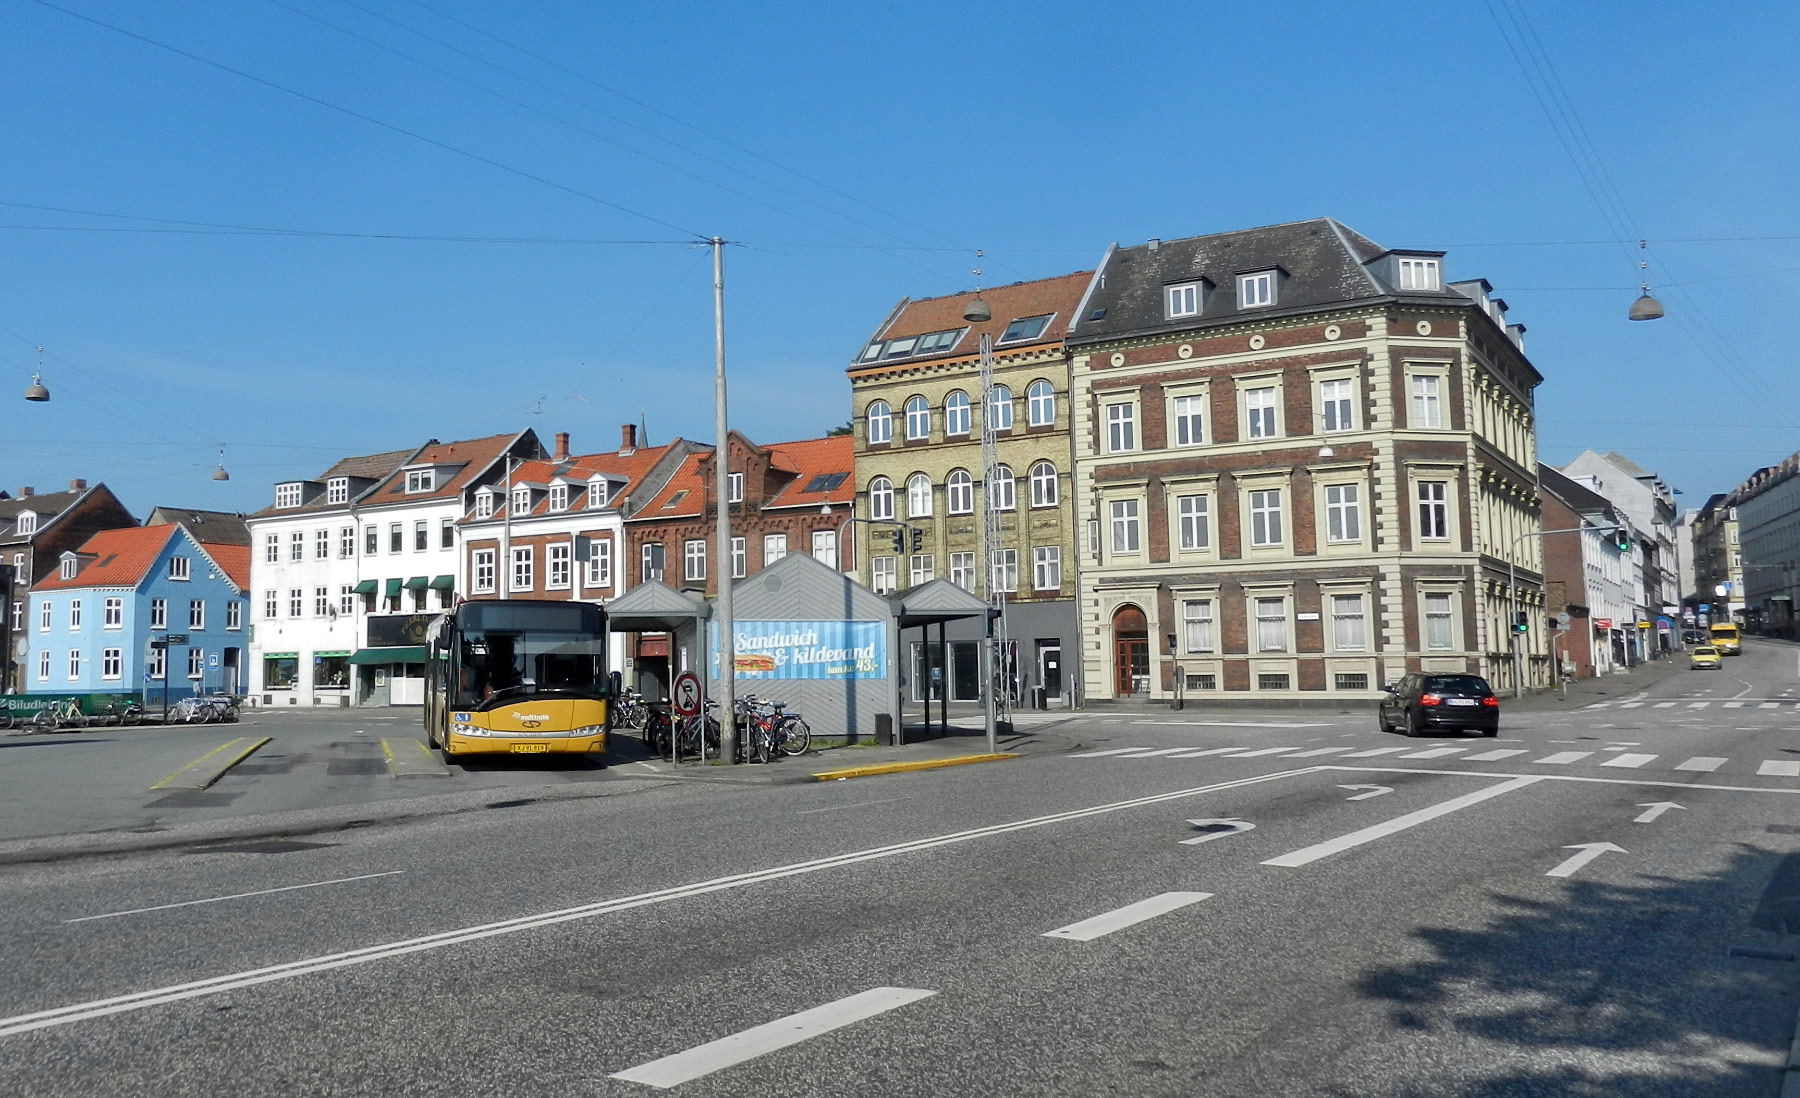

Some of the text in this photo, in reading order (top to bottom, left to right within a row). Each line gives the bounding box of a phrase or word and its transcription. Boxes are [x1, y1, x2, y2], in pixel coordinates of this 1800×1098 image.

[736, 628, 818, 651] Sandwich
[775, 642, 875, 666] & kildevand
